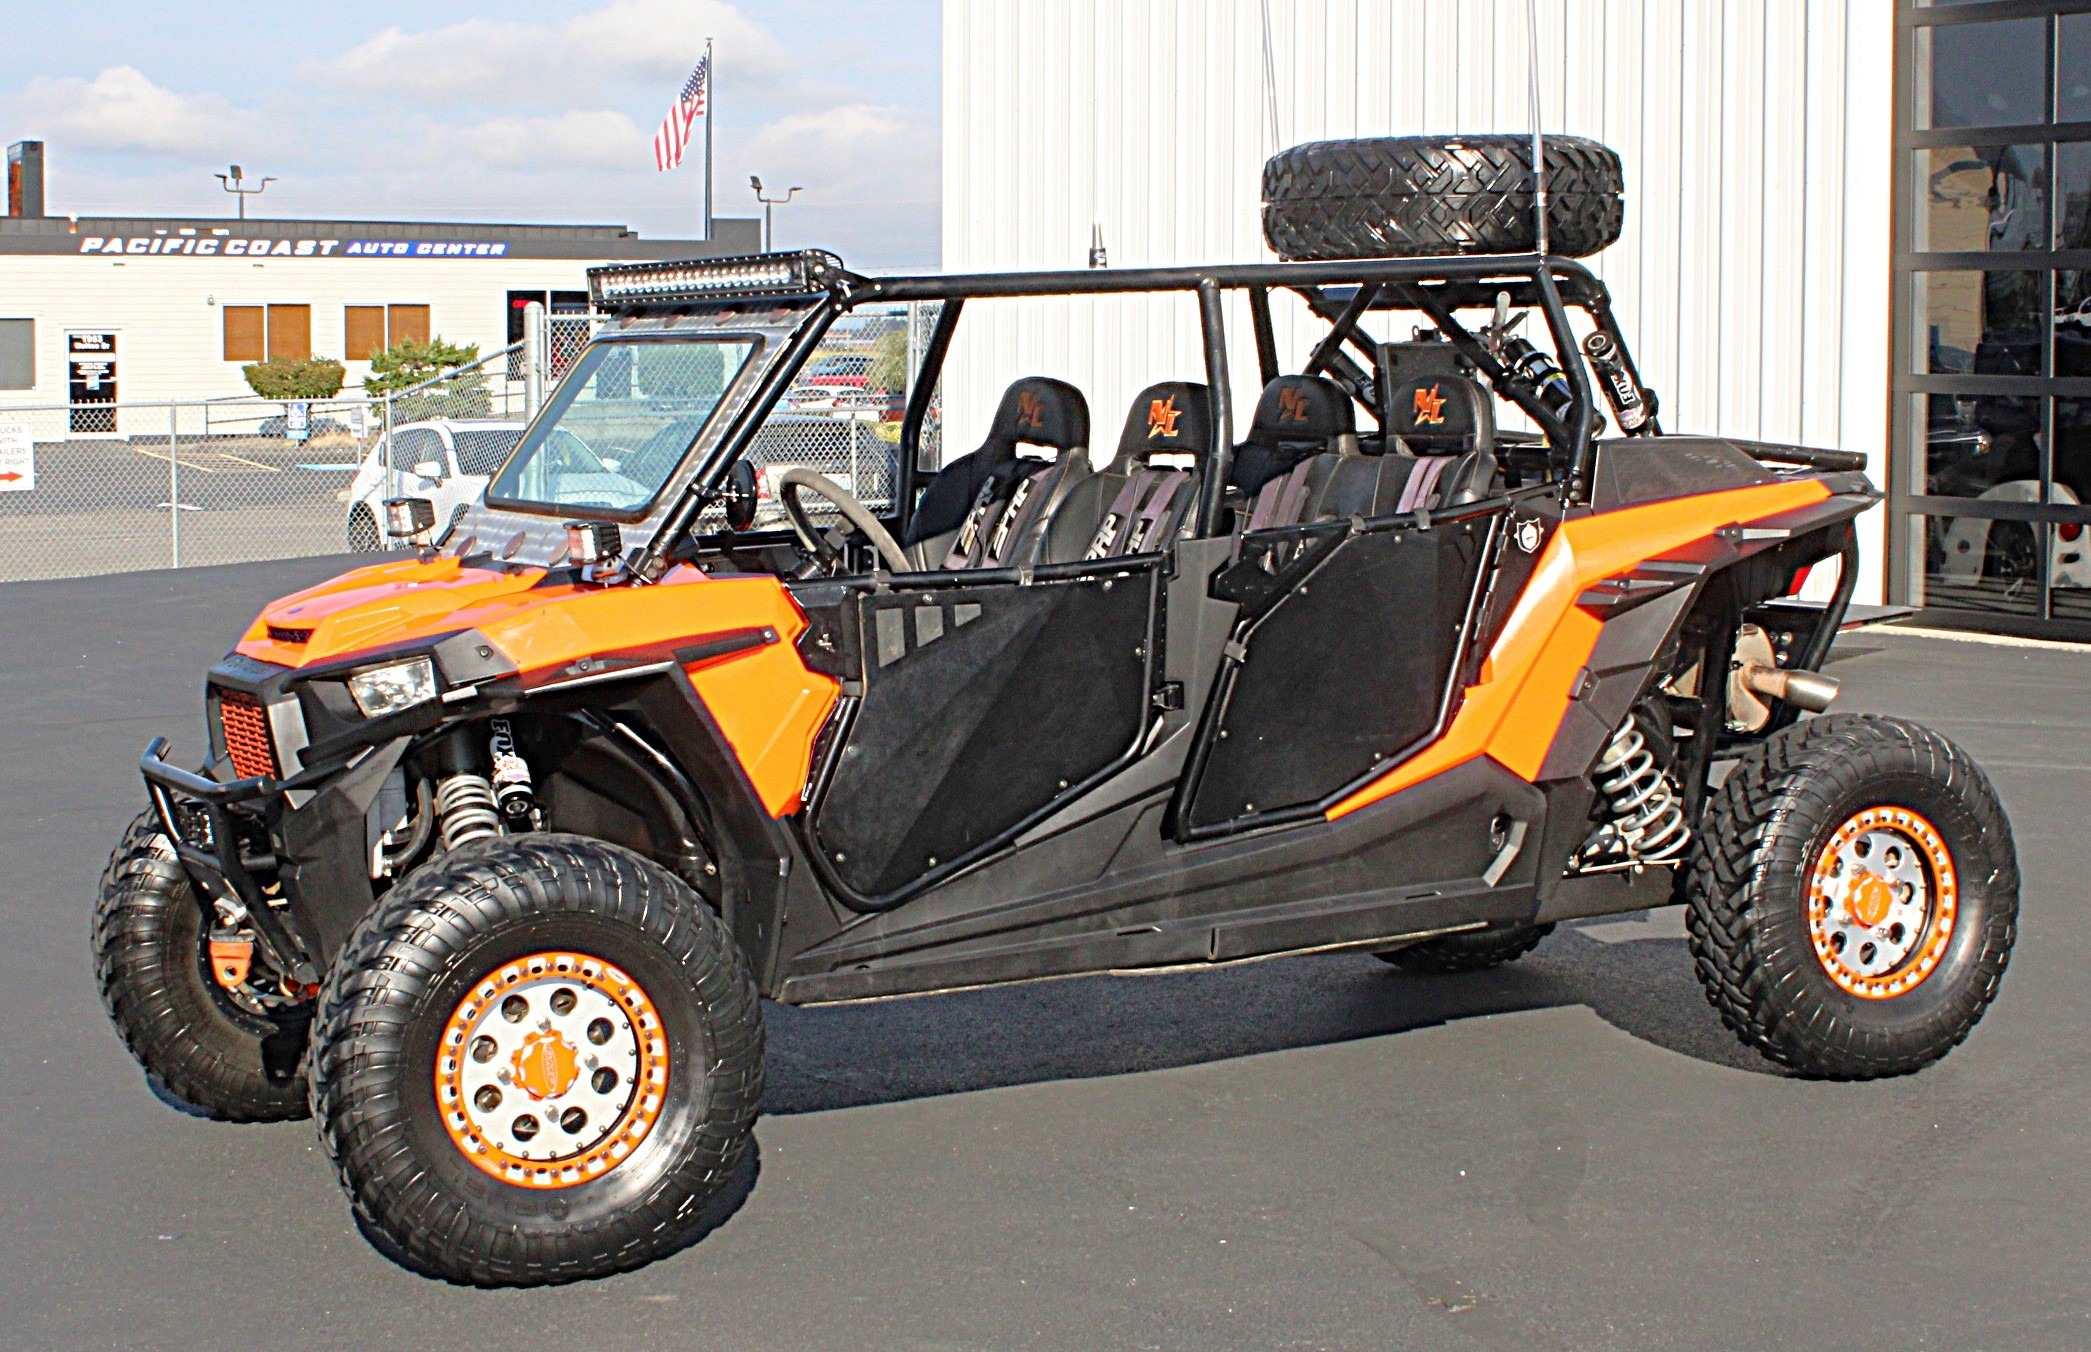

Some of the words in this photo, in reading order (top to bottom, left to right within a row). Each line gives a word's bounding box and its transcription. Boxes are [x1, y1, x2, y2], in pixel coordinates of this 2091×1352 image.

[80, 237, 219, 254] PACIFIC
[224, 239, 339, 255] COAST
[347, 242, 409, 254] AUTO
[416, 243, 505, 255] CENTER
